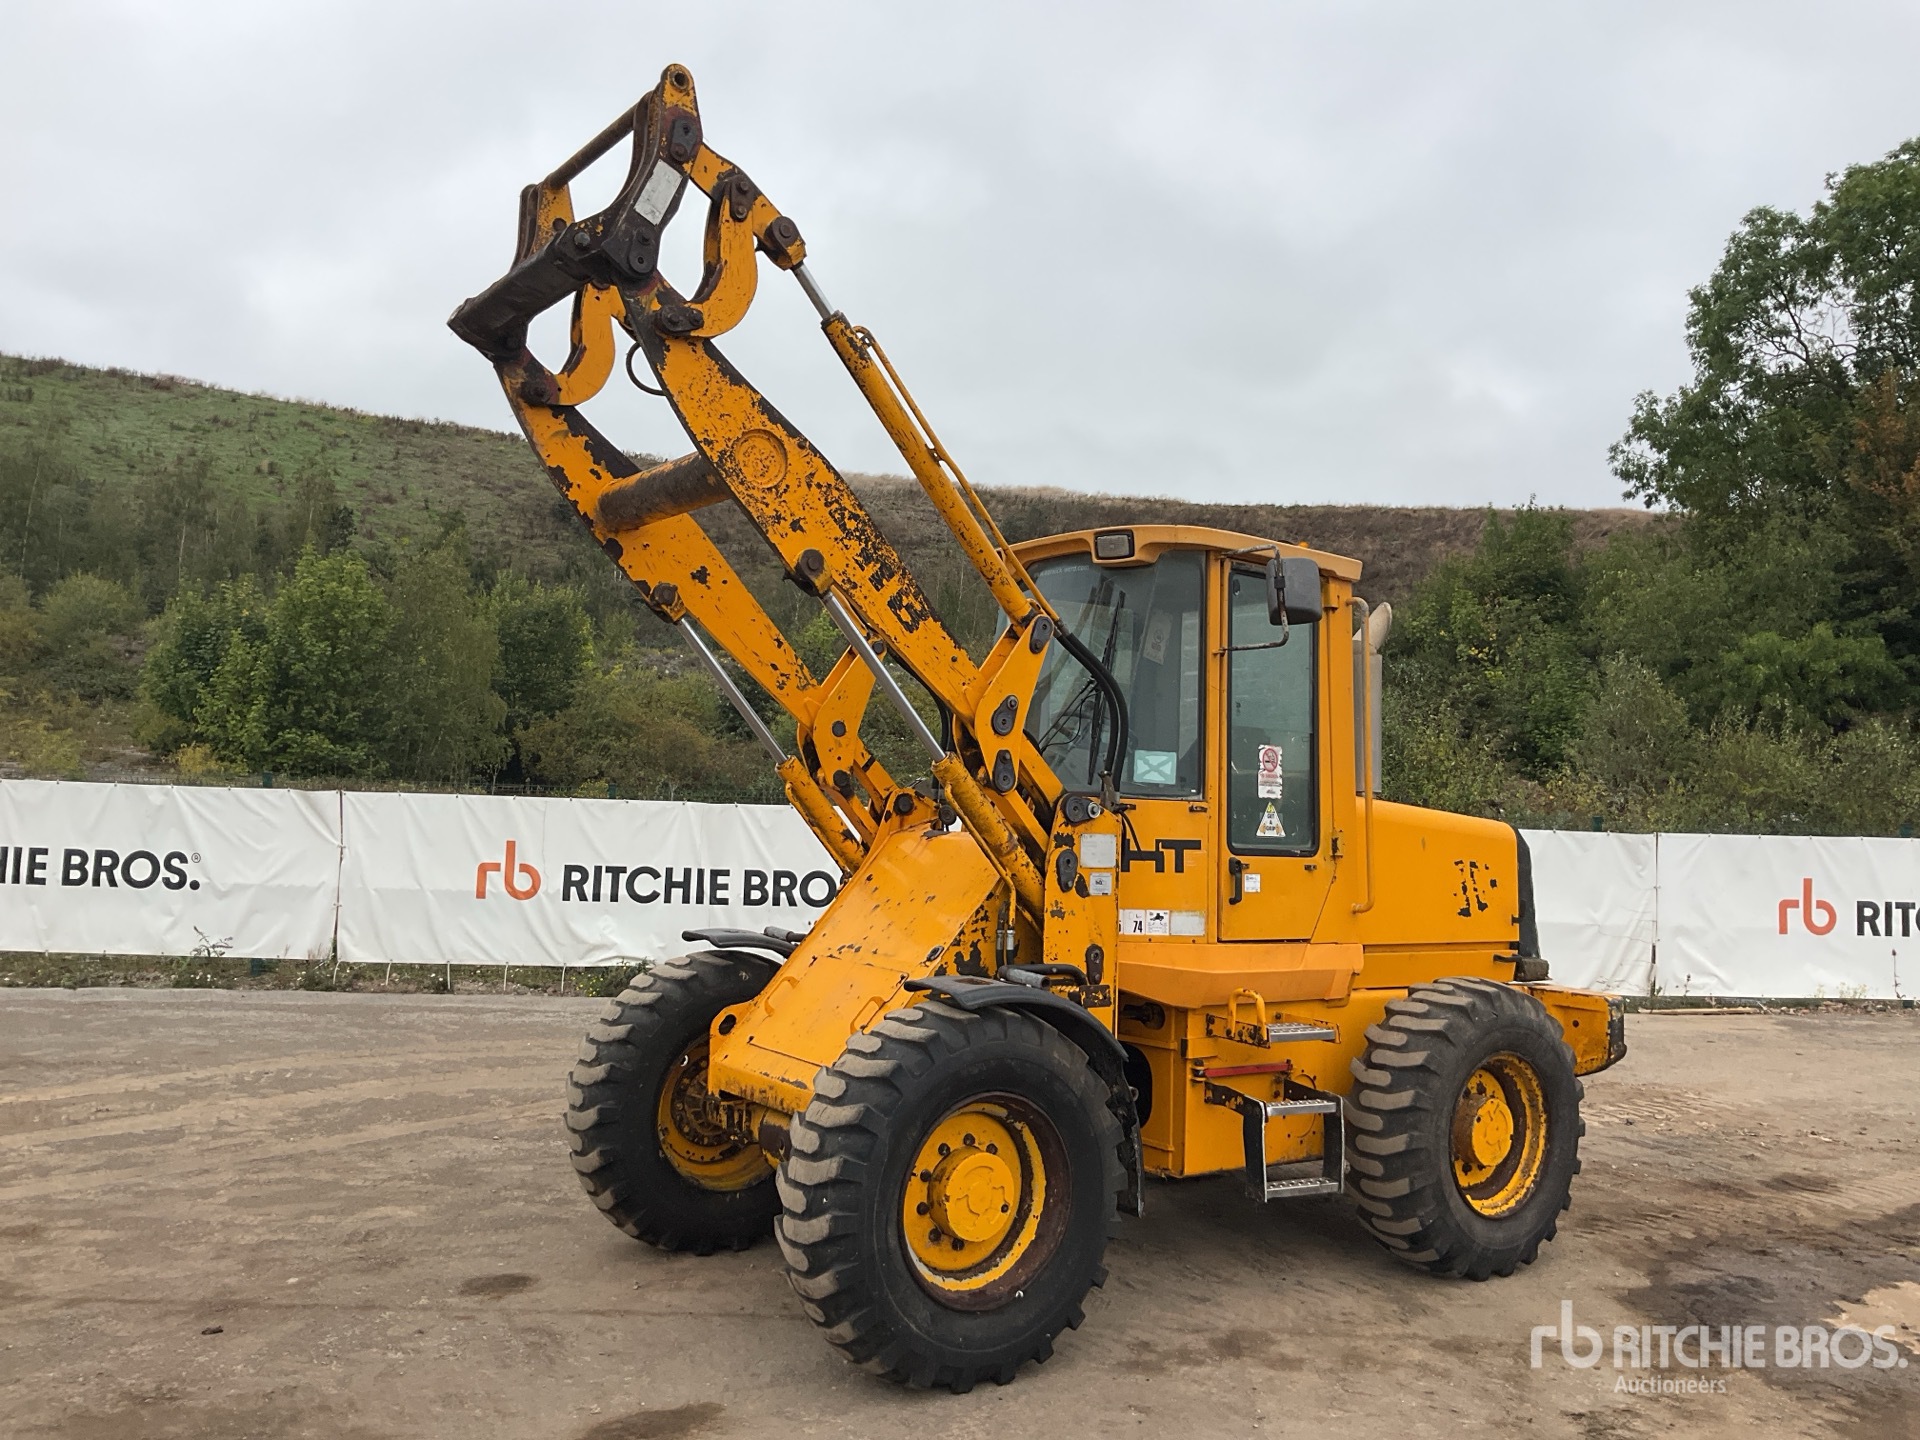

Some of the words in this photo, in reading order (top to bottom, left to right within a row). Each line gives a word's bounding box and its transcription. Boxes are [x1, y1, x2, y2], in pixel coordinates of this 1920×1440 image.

[475, 839, 542, 901] rb
[561, 864, 731, 906] RITCHIE
[742, 868, 848, 908] BRO
[1133, 920, 1143, 933] 74
[1778, 877, 1837, 936] rb
[1856, 900, 1920, 937] RIT
